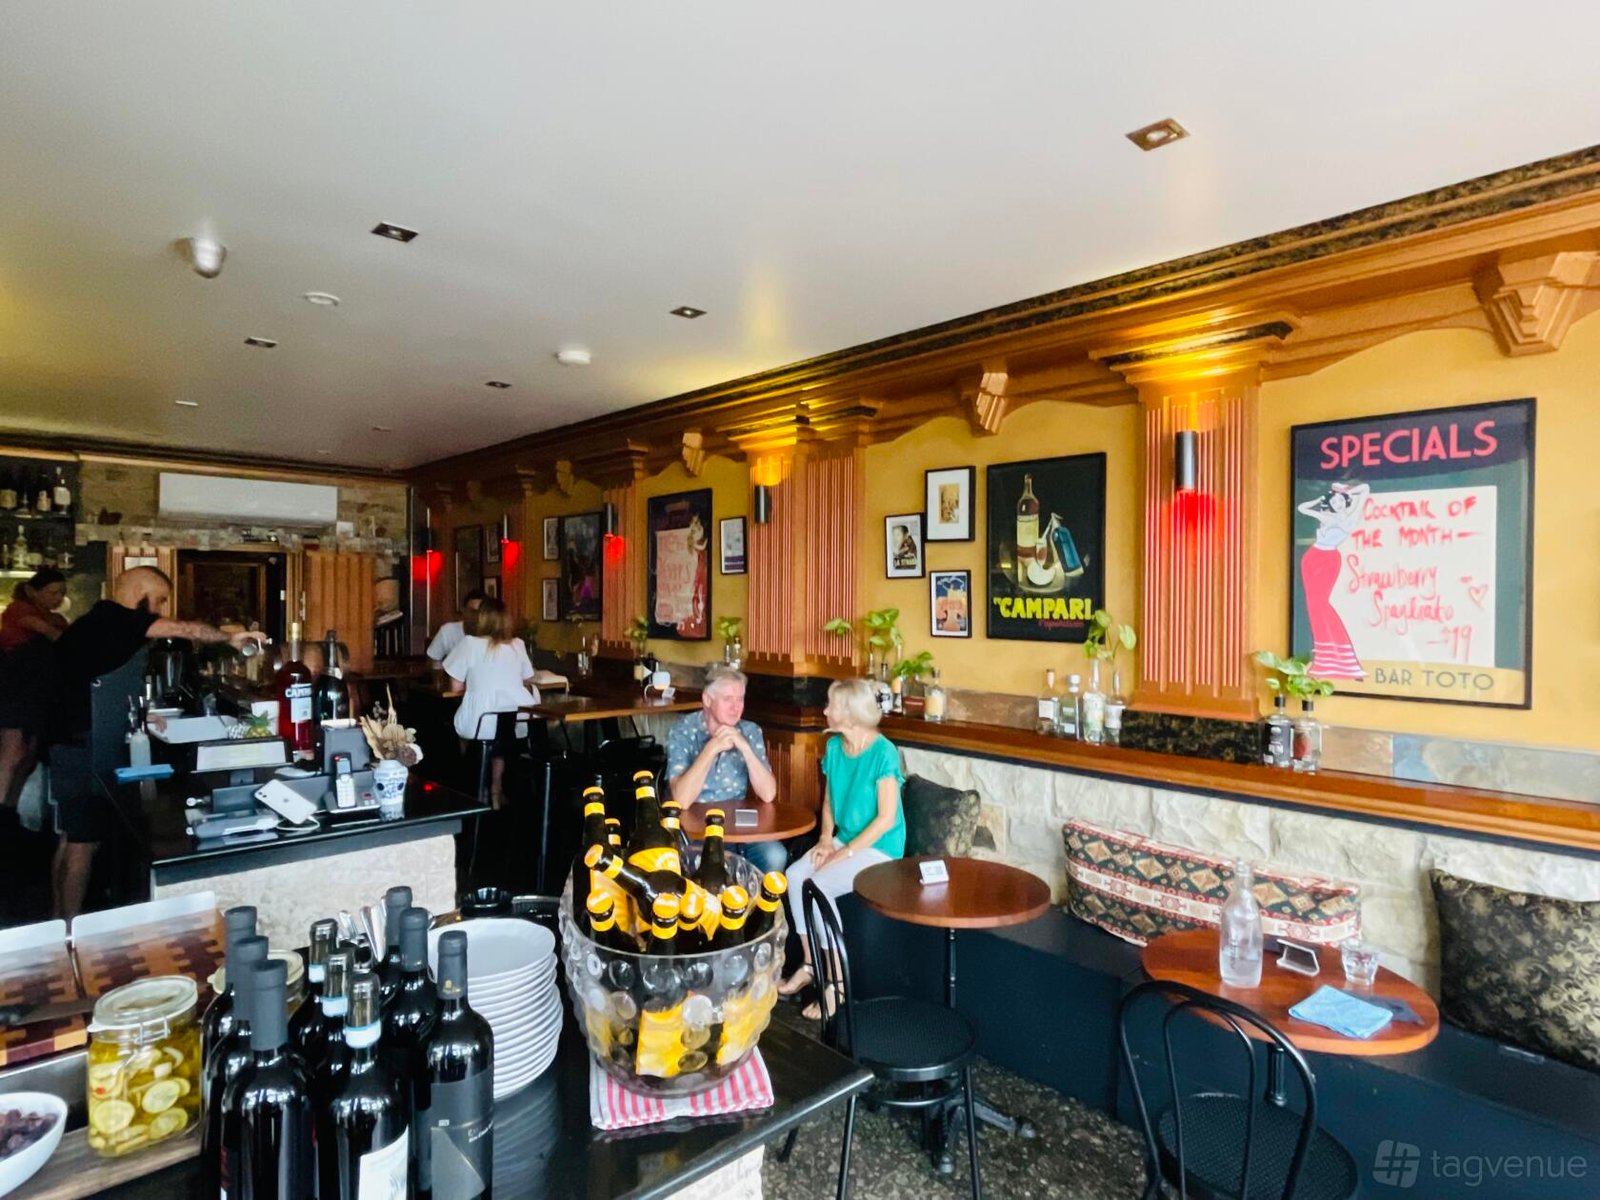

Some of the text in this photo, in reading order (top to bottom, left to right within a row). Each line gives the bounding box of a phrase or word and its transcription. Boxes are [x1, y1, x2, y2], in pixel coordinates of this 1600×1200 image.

[1321, 421, 1498, 470] SPECIALS
[1448, 496, 1478, 517] OF
[1352, 529, 1384, 549] THE
[1375, 668, 1494, 691] BAR TOTO
